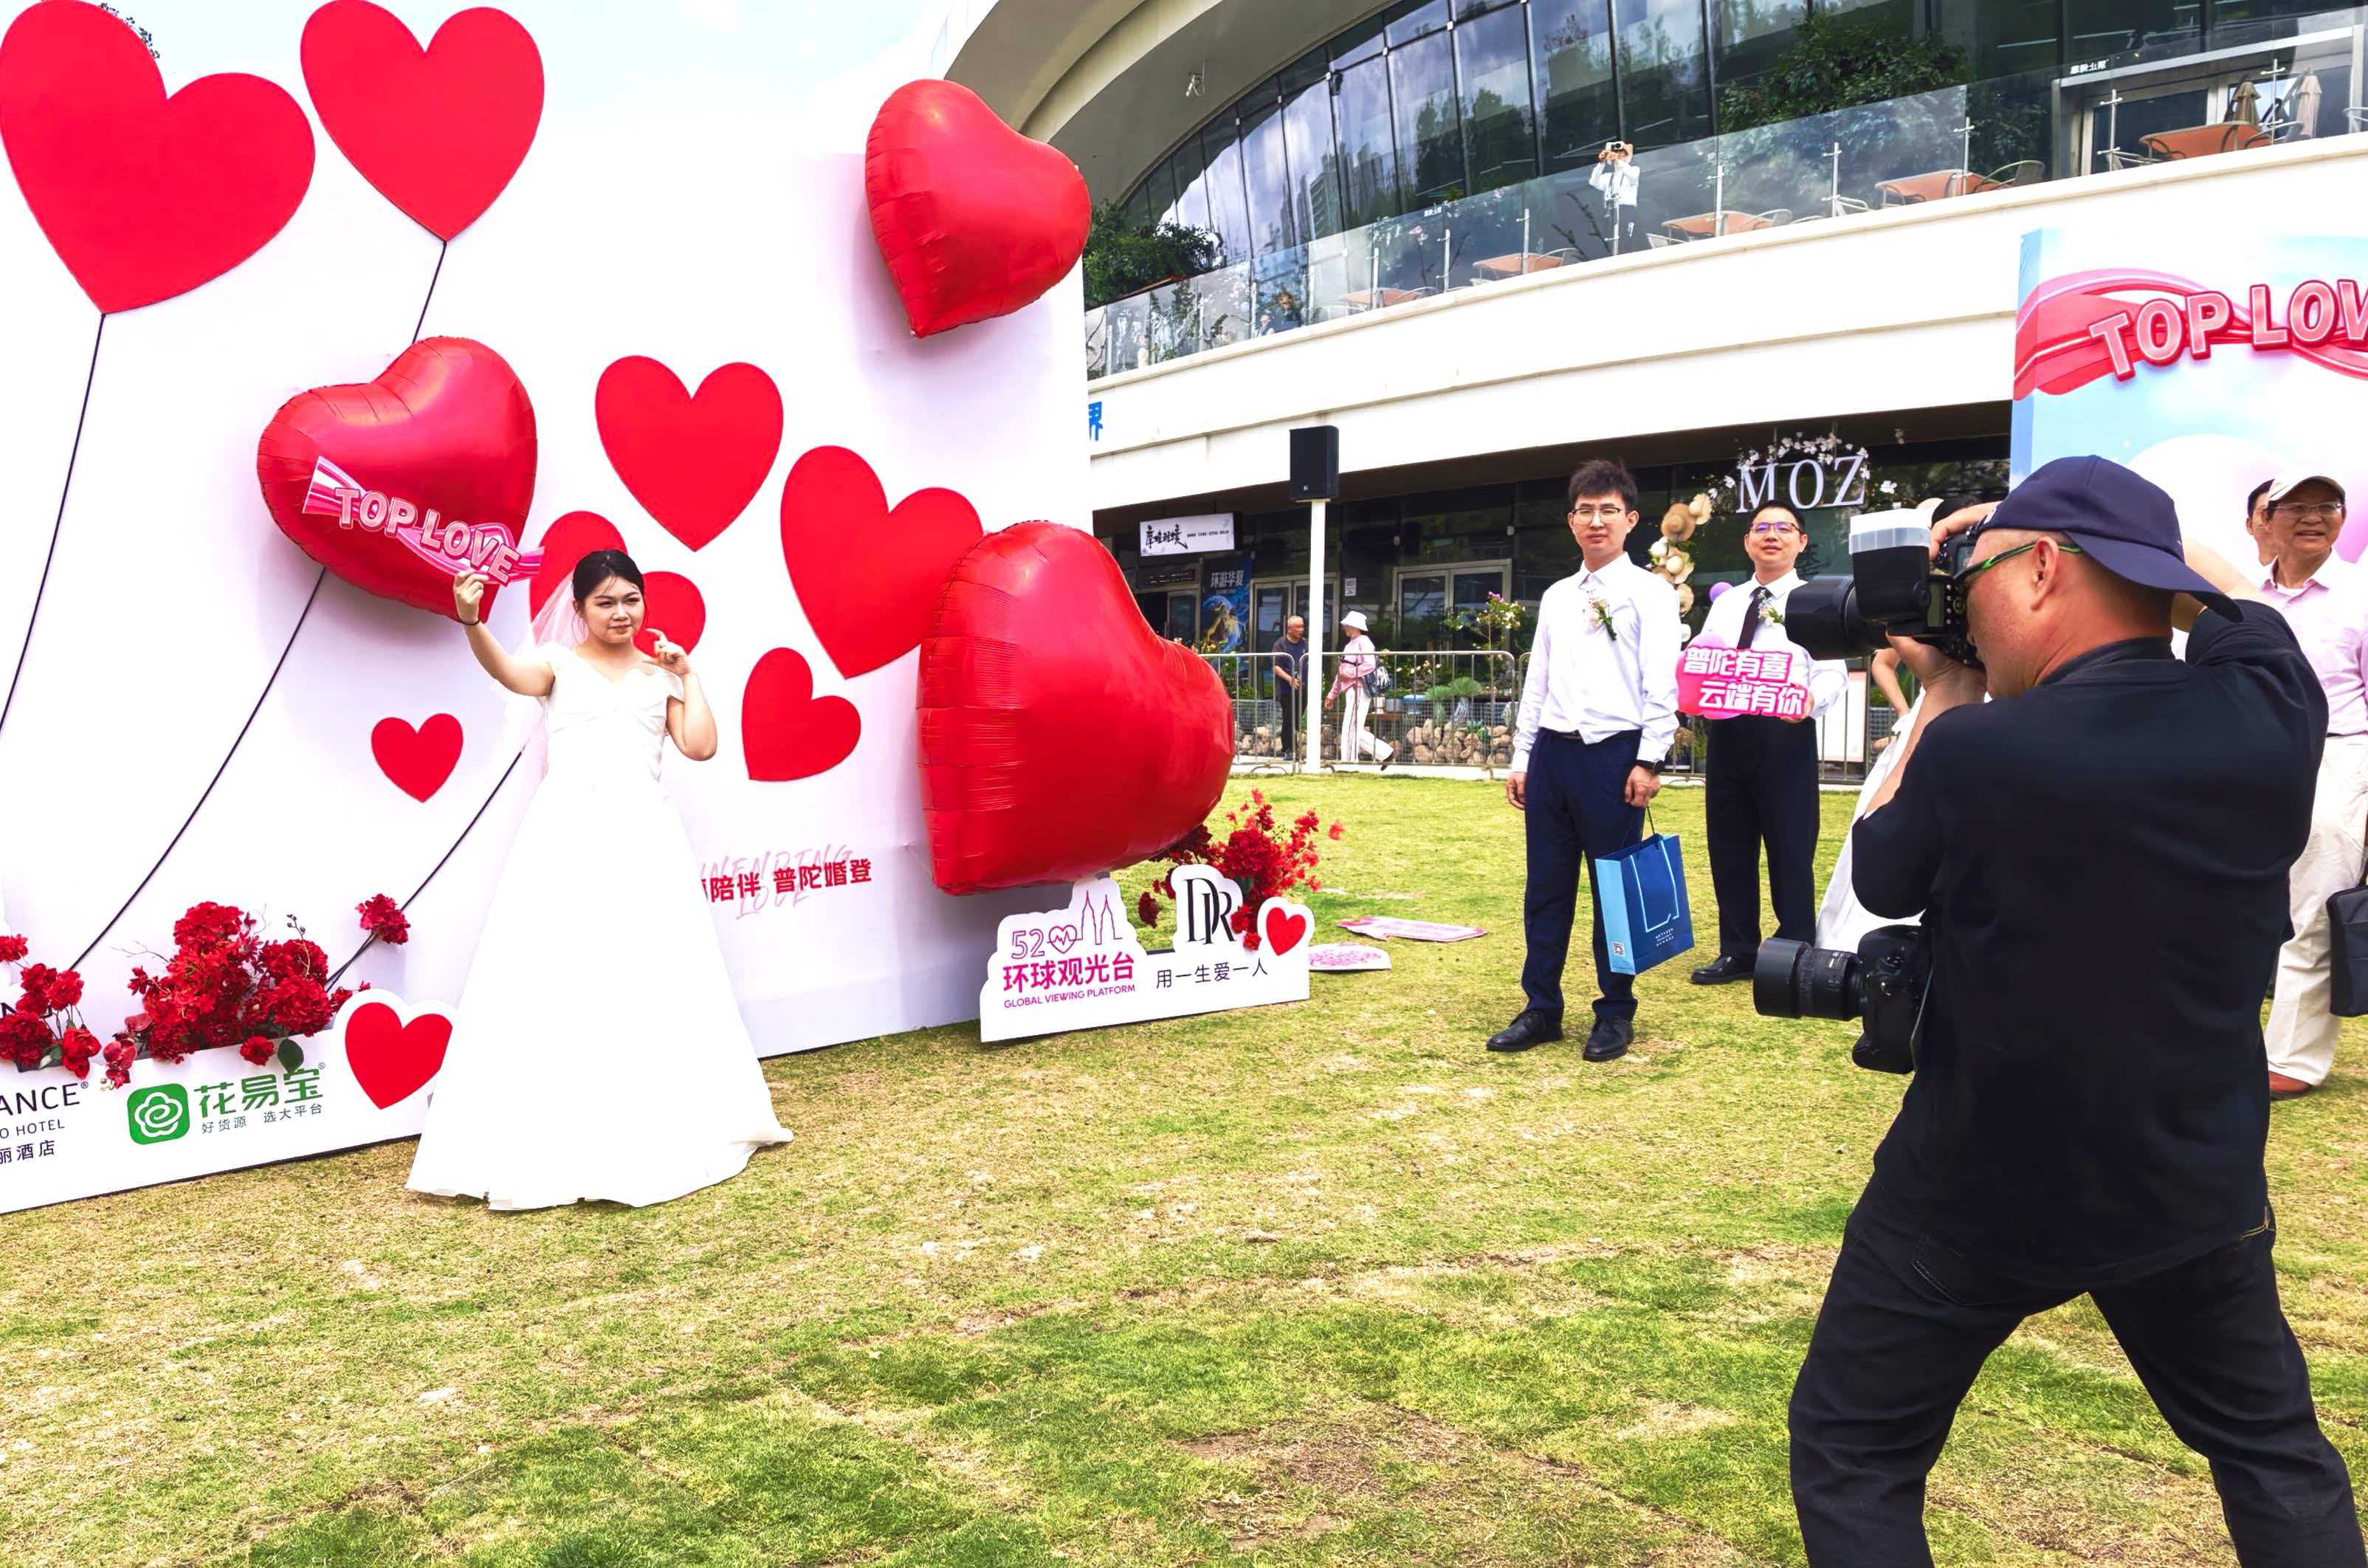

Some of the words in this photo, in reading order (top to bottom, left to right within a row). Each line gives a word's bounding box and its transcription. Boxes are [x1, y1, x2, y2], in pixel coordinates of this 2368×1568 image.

[2089, 291, 2234, 382] TOP
[1736, 455, 1865, 513] MOZ
[335, 488, 417, 537] TOP
[420, 509, 521, 588] LOVE
[1684, 647, 1790, 681] 普陀有喜
[1699, 681, 1806, 715] 云端有你
[701, 872, 761, 902] 陪伴
[774, 859, 872, 894] 普陀婚登
[1002, 952, 1135, 993] 环球观光台
[1156, 957, 1268, 989] 用一生爱一人
[1004, 997, 1042, 1008] GLOBAL
[1045, 990, 1085, 1003] VIEWING
[1087, 985, 1136, 997] PLATFORM
[193, 1068, 323, 1118] 花易宝
[16, 1118, 65, 1136] HOTEL
[202, 1115, 247, 1134] 好货源
[264, 1103, 323, 1123] 选大平台
